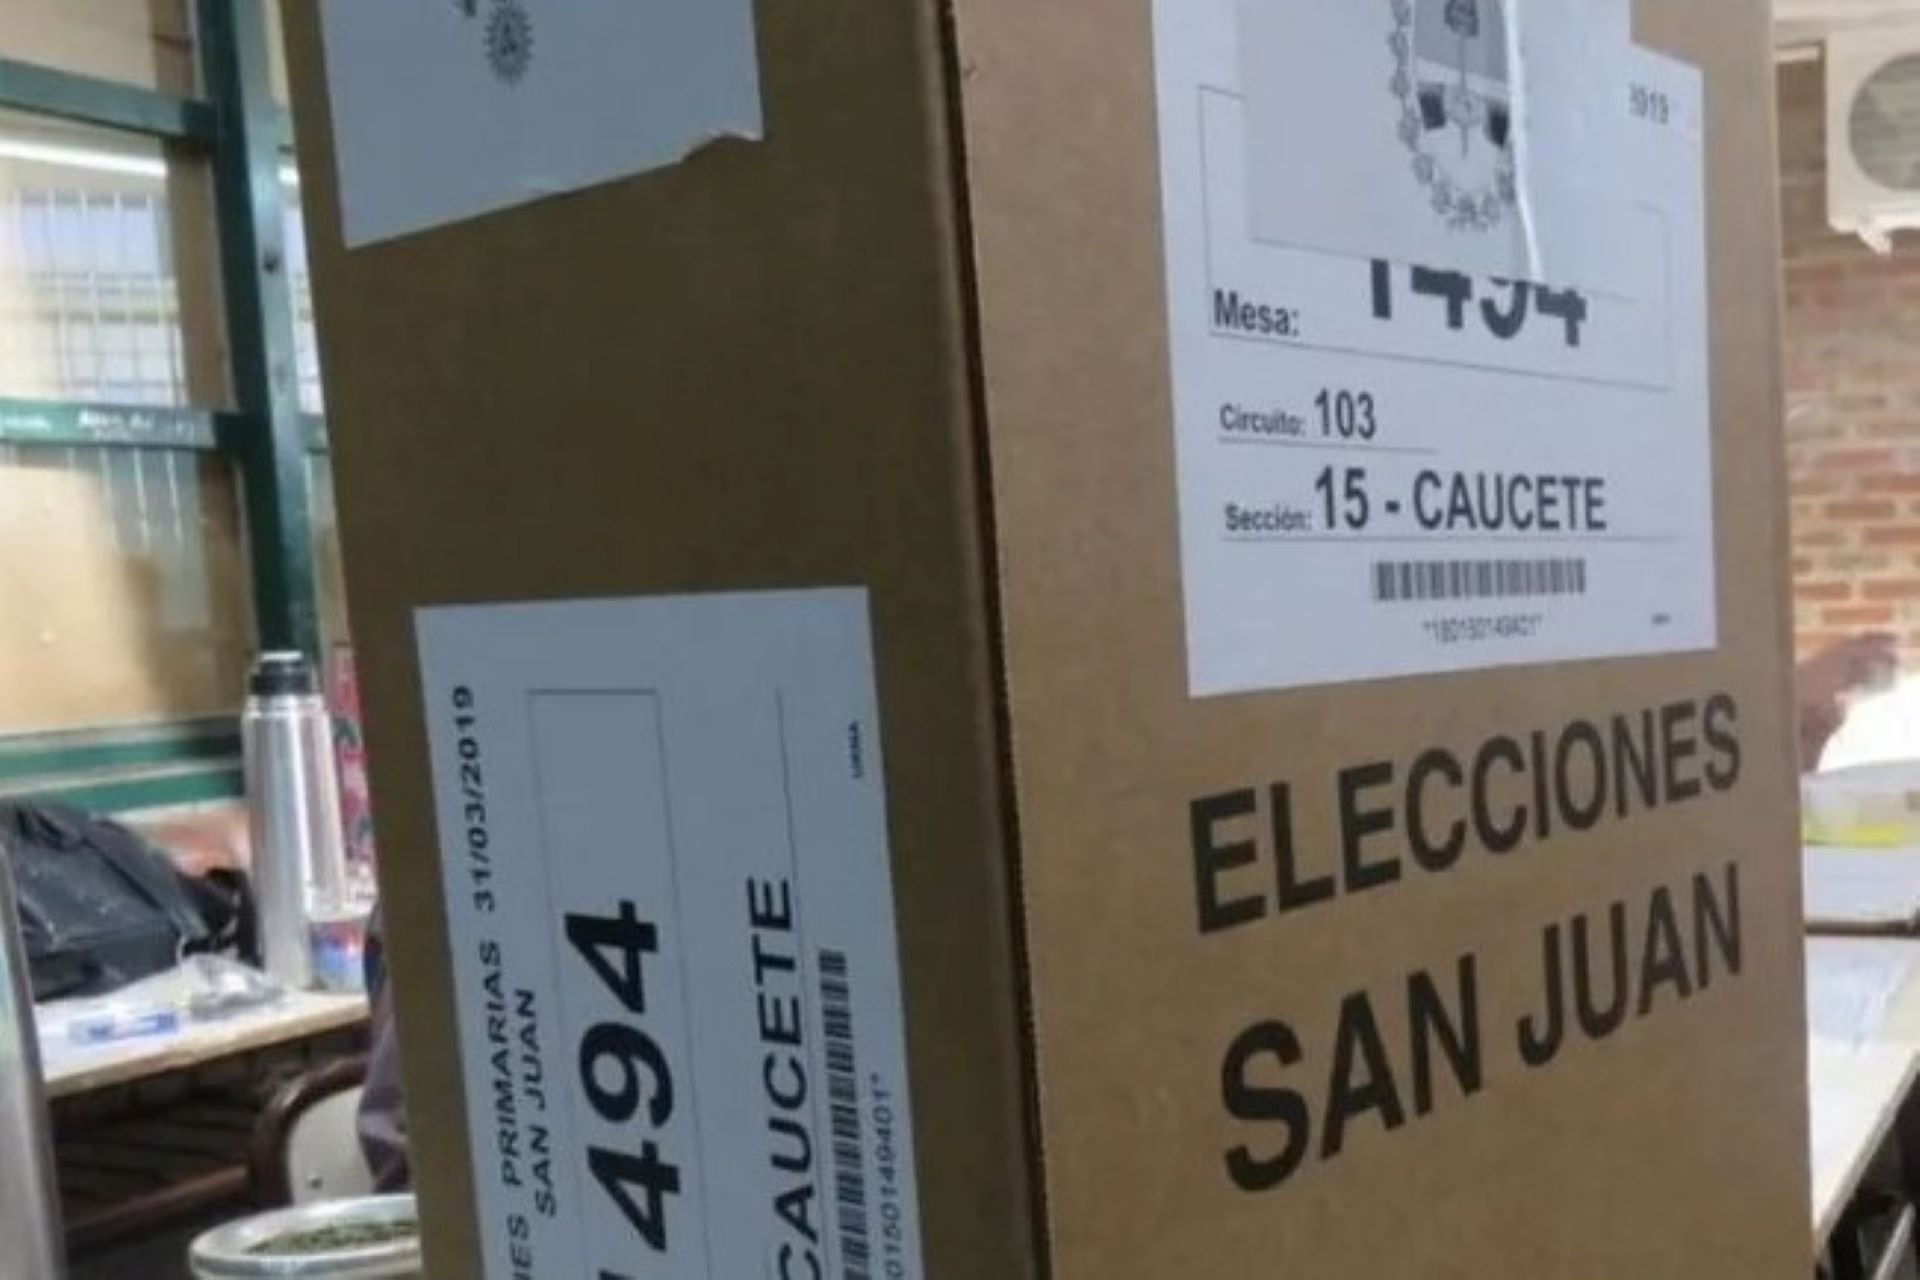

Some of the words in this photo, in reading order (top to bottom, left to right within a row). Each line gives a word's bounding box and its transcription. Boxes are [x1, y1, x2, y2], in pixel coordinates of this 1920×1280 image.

[1213, 288, 1300, 337] Mesa:
[1219, 402, 1305, 437] Circuito:
[1314, 387, 1377, 440] 103
[1224, 501, 1313, 532] Sección:
[1314, 464, 1369, 530] 15
[1411, 470, 1607, 531] CAUCETE
[452, 685, 498, 912] 31/03/2019
[1189, 694, 1742, 935] ELECCIONES
[480, 940, 523, 1186] PRIMARIAS
[514, 989, 547, 1111] JUAN
[1221, 953, 1483, 1191] SAN
[1516, 861, 1742, 1066] JUAN
[522, 1125, 557, 1217] SAN
